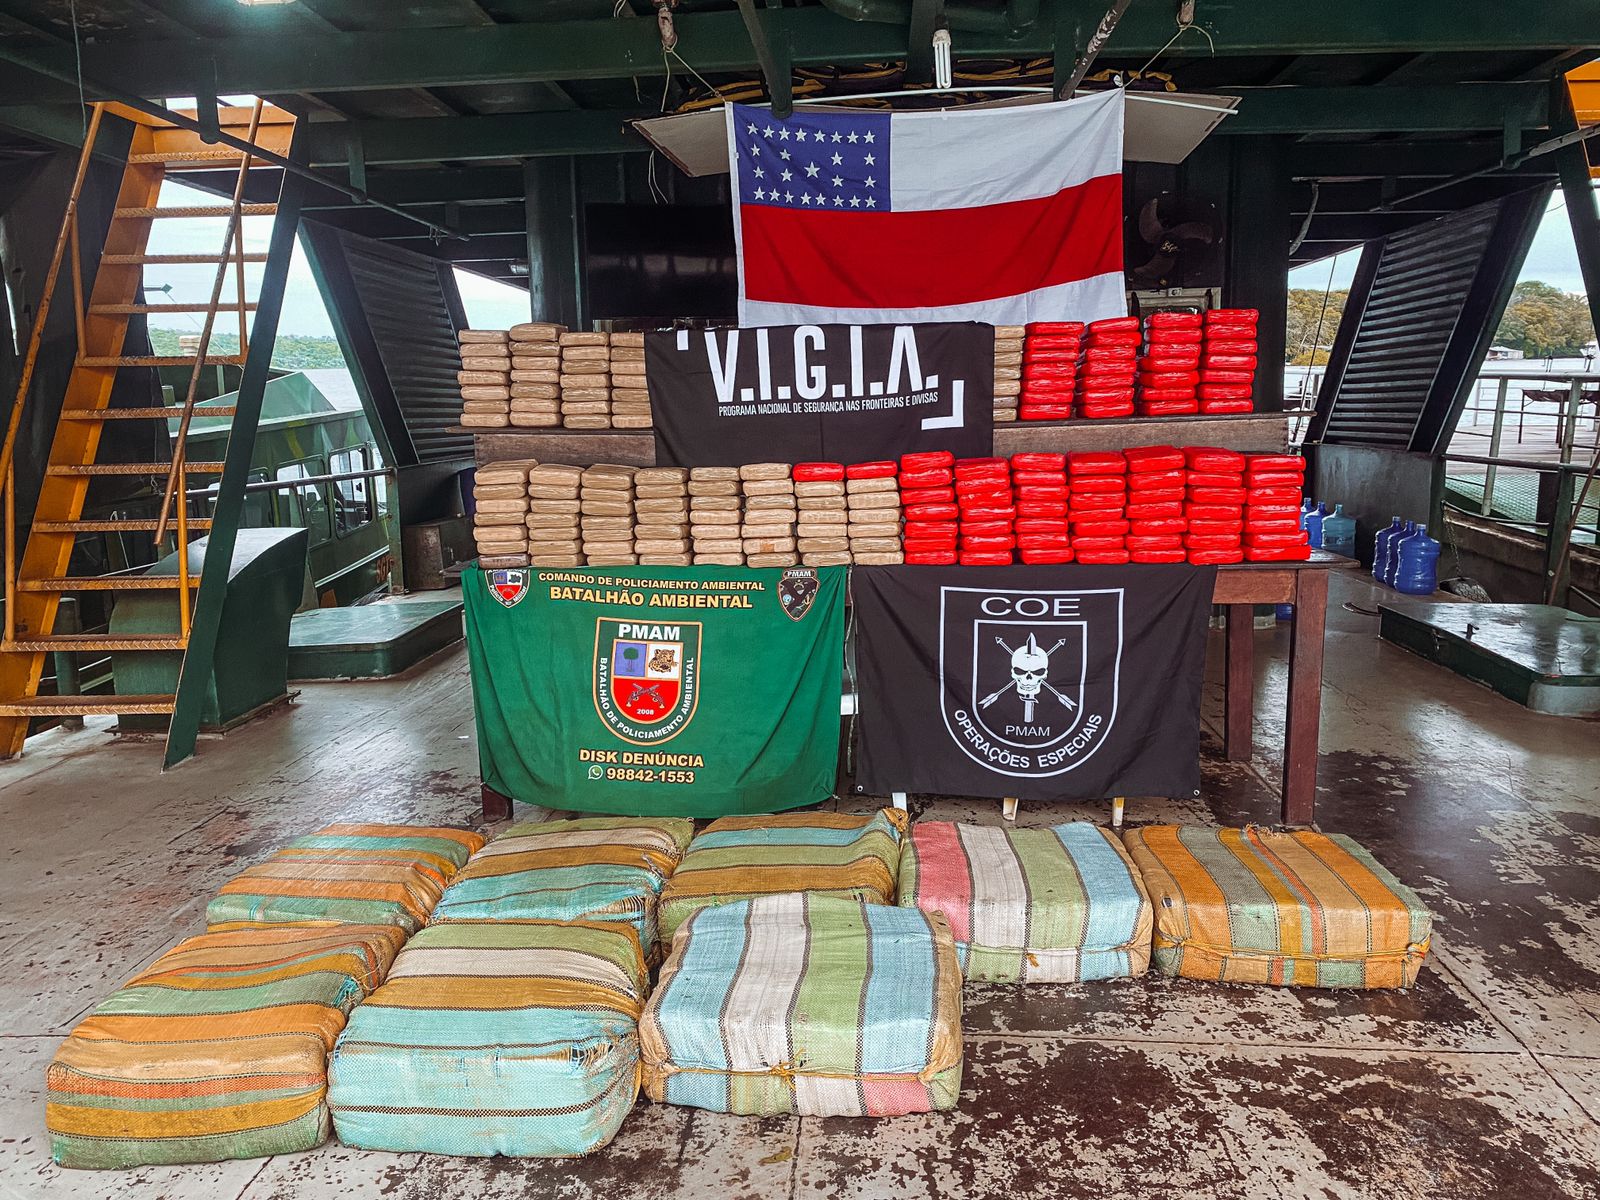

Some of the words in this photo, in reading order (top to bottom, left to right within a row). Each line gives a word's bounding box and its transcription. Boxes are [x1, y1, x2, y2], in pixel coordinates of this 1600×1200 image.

[704, 325, 938, 403] V.I.G.I.A.
[719, 405, 757, 417] PROGRAMA
[758, 403, 791, 416] NACIONAL
[793, 402, 802, 414] DE
[803, 401, 844, 414] SEGURANÇA
[845, 400, 860, 411] NAS
[861, 396, 904, 410] FRONTEIRAS
[905, 396, 911, 406] E
[912, 391, 939, 406] DIVISAS
[538, 572, 595, 585] COMANDO
[597, 576, 613, 586] DE
[615, 577, 699, 590] POLICIAMENTO
[701, 581, 765, 591] AMBIENTAL
[550, 586, 645, 606] BATALHÃO
[649, 593, 753, 608] AMBIENTAL
[981, 596, 1081, 617] COE
[618, 623, 681, 641] PMAM
[599, 657, 610, 710] BATALHÃO
[606, 711, 619, 724] DE
[617, 714, 684, 739] POLICIAMENTO
[681, 657, 694, 715] AMBIENTAL
[636, 708, 655, 716] 2008
[954, 709, 1030, 768] OPERAÇÕES
[1038, 714, 1102, 768] ESPECIAIS
[1005, 725, 1050, 737] PMAM
[579, 749, 618, 763] DISK
[622, 751, 704, 767] DENÚNCIA
[606, 767, 695, 783] 98842-1553
